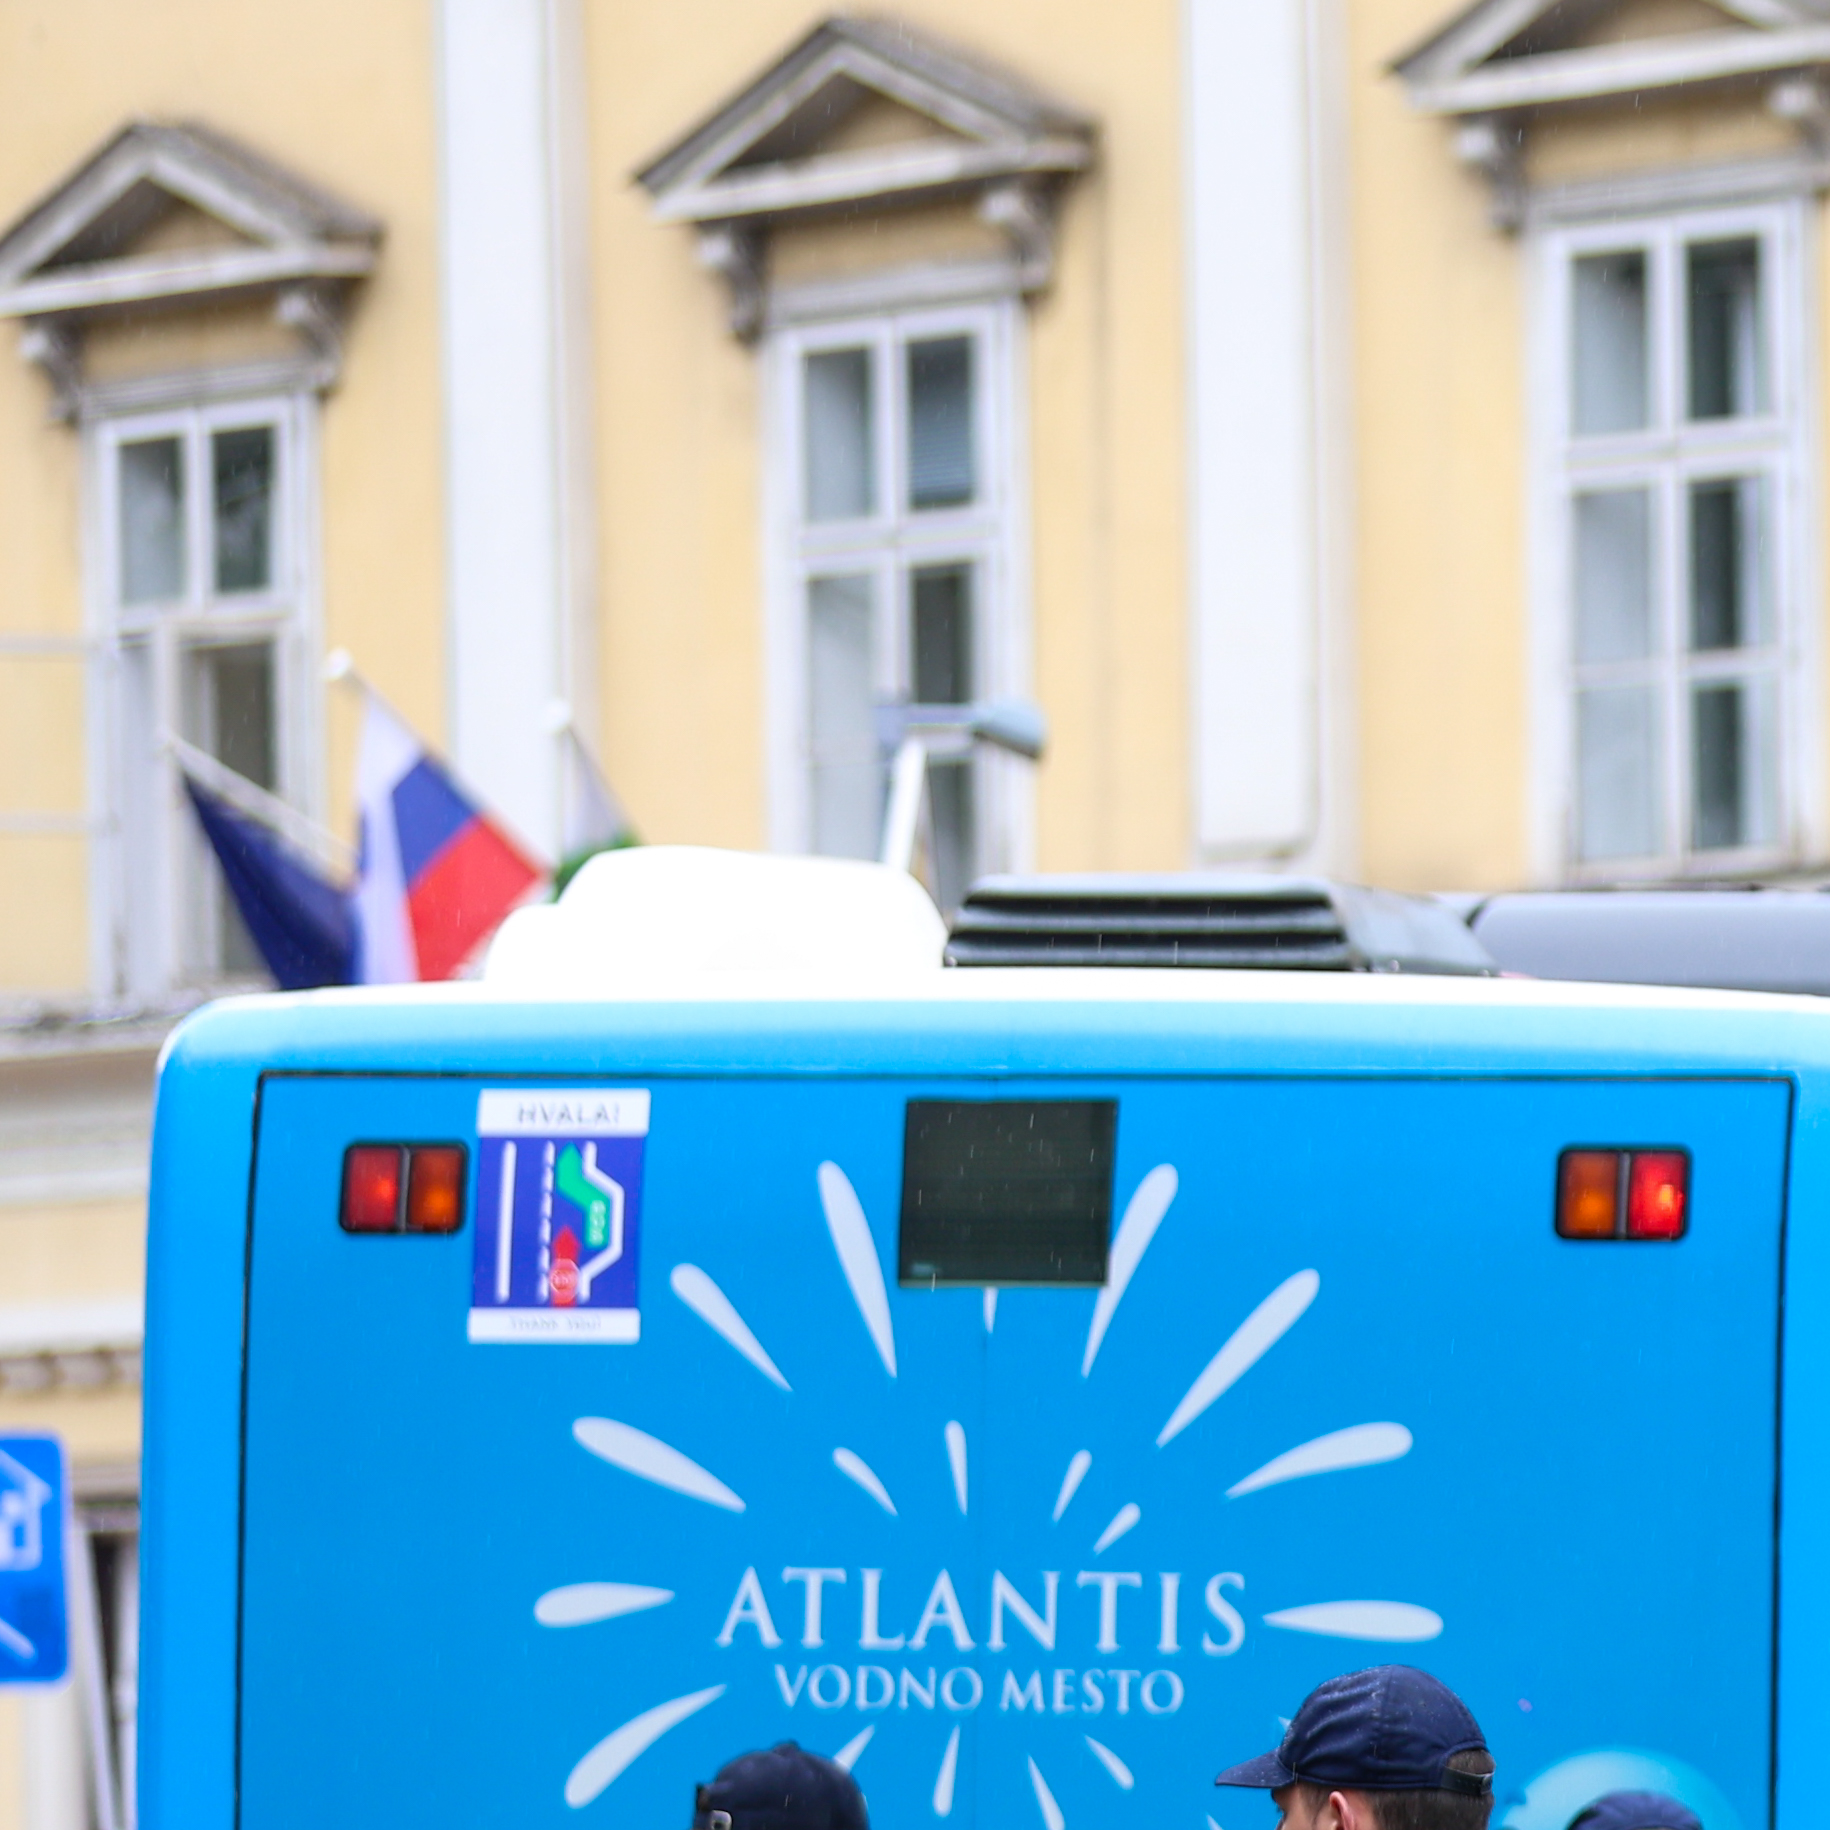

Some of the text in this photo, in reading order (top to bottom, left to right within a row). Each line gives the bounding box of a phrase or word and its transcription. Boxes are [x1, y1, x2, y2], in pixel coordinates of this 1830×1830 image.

[518, 1102, 620, 1124] HVALA!
[714, 1565, 1246, 1657] ATLANTIS
[774, 1663, 1186, 1715] VODNO MESTO
